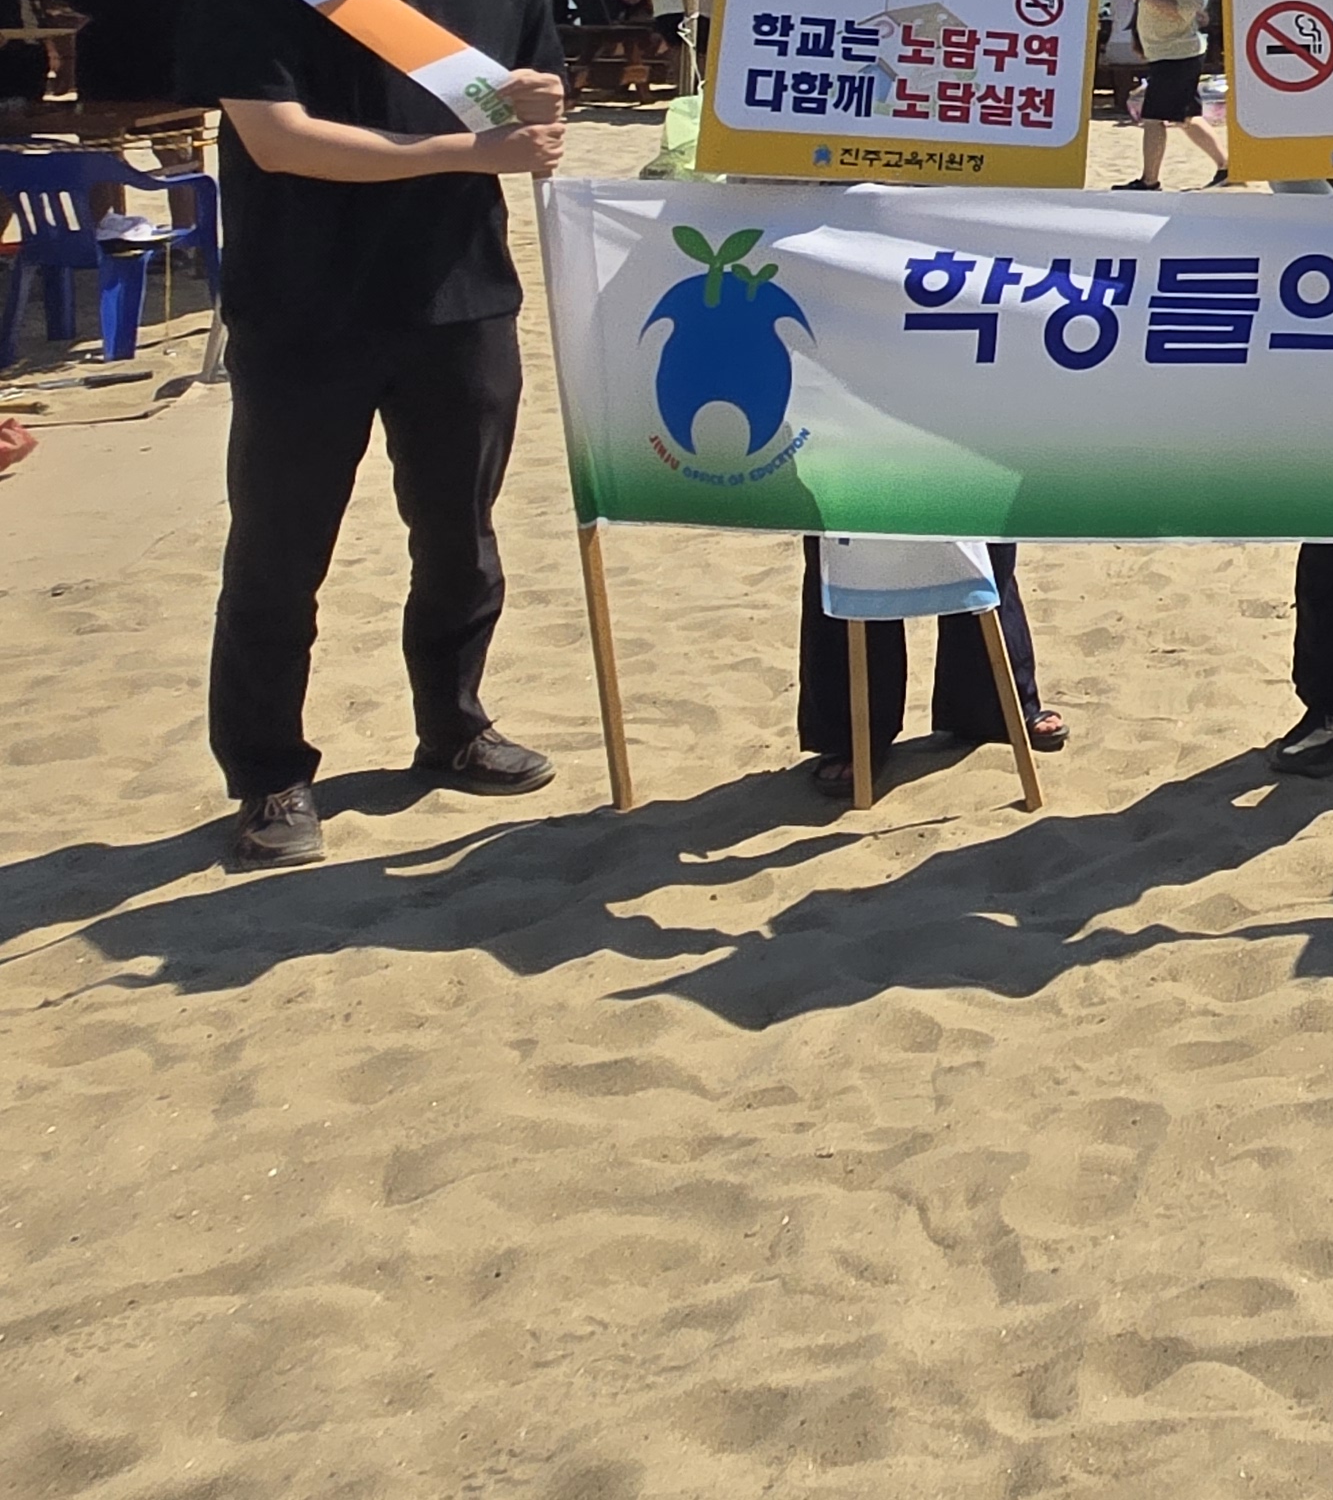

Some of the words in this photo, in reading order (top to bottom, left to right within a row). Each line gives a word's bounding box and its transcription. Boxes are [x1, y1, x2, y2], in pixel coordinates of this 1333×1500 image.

[752, 13, 880, 62] 학교는
[897, 24, 1059, 75] 노담구역
[744, 68, 875, 118] 다함께
[892, 79, 1056, 129] 노담실천
[650, 434, 680, 471] JINJU
[749, 427, 811, 482] EDUCATION
